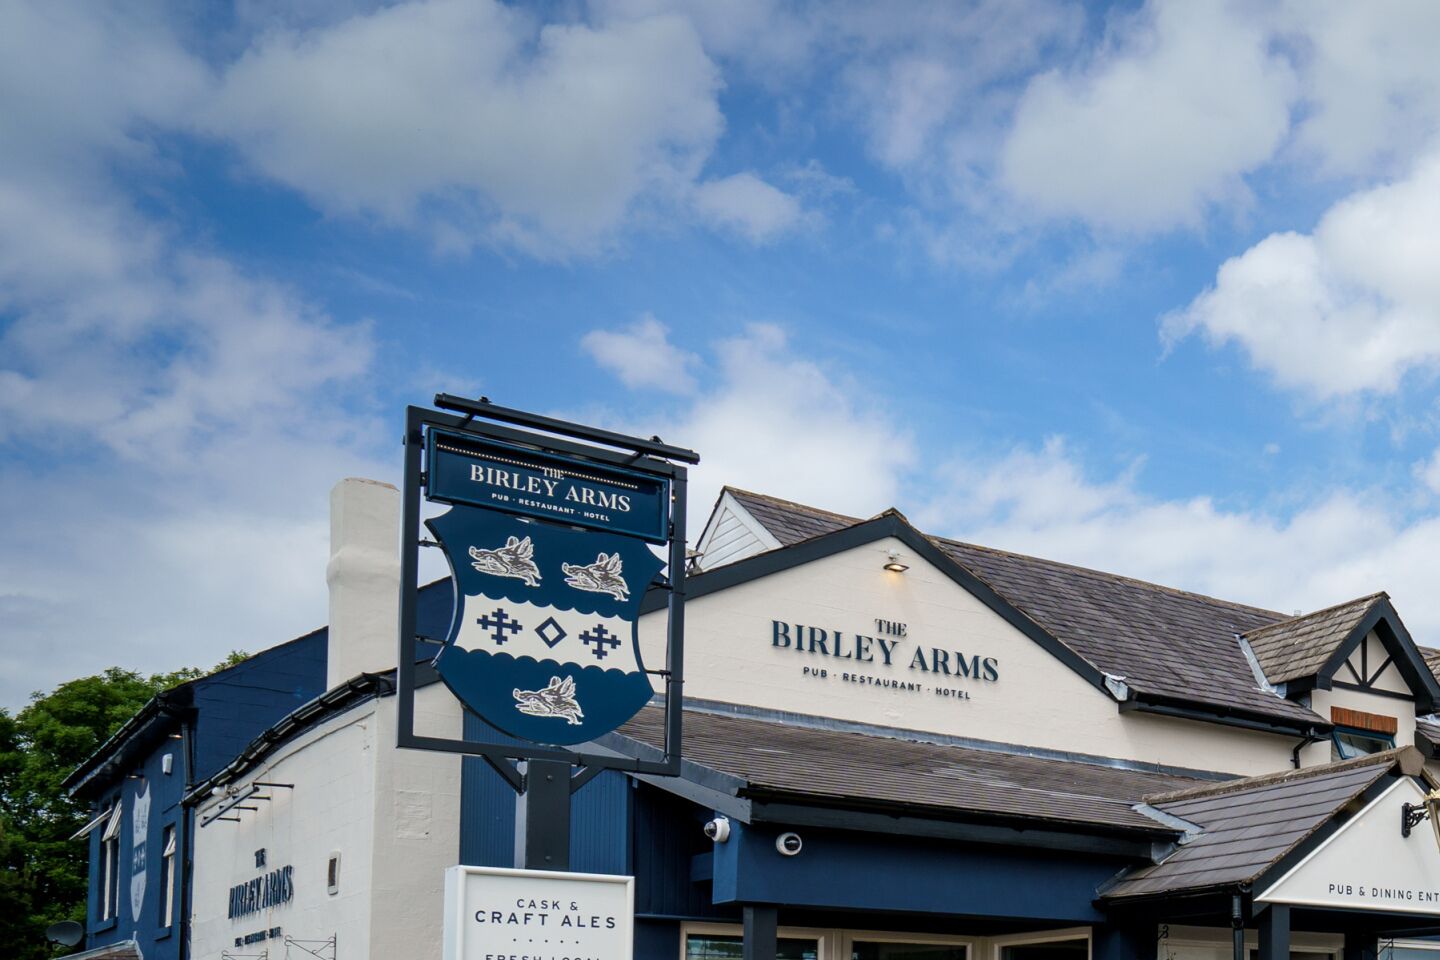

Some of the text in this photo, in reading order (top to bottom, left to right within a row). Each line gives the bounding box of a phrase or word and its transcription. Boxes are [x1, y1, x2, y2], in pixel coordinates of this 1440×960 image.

[541, 467, 565, 480] THE
[470, 463, 631, 512] BIRLEY ARMS
[491, 493, 610, 522] PUB RESTAURANT HOTEL
[874, 618, 907, 637] THE
[771, 619, 999, 682] BIRLEY ARMS
[803, 666, 971, 700] PUB RESTAURANT HOTEL
[1329, 883, 1353, 895] PUB
[1359, 886, 1366, 897] &
[1372, 888, 1413, 900] DINING
[516, 898, 579, 911] CASK &
[475, 910, 617, 929] CRAFT ALES
